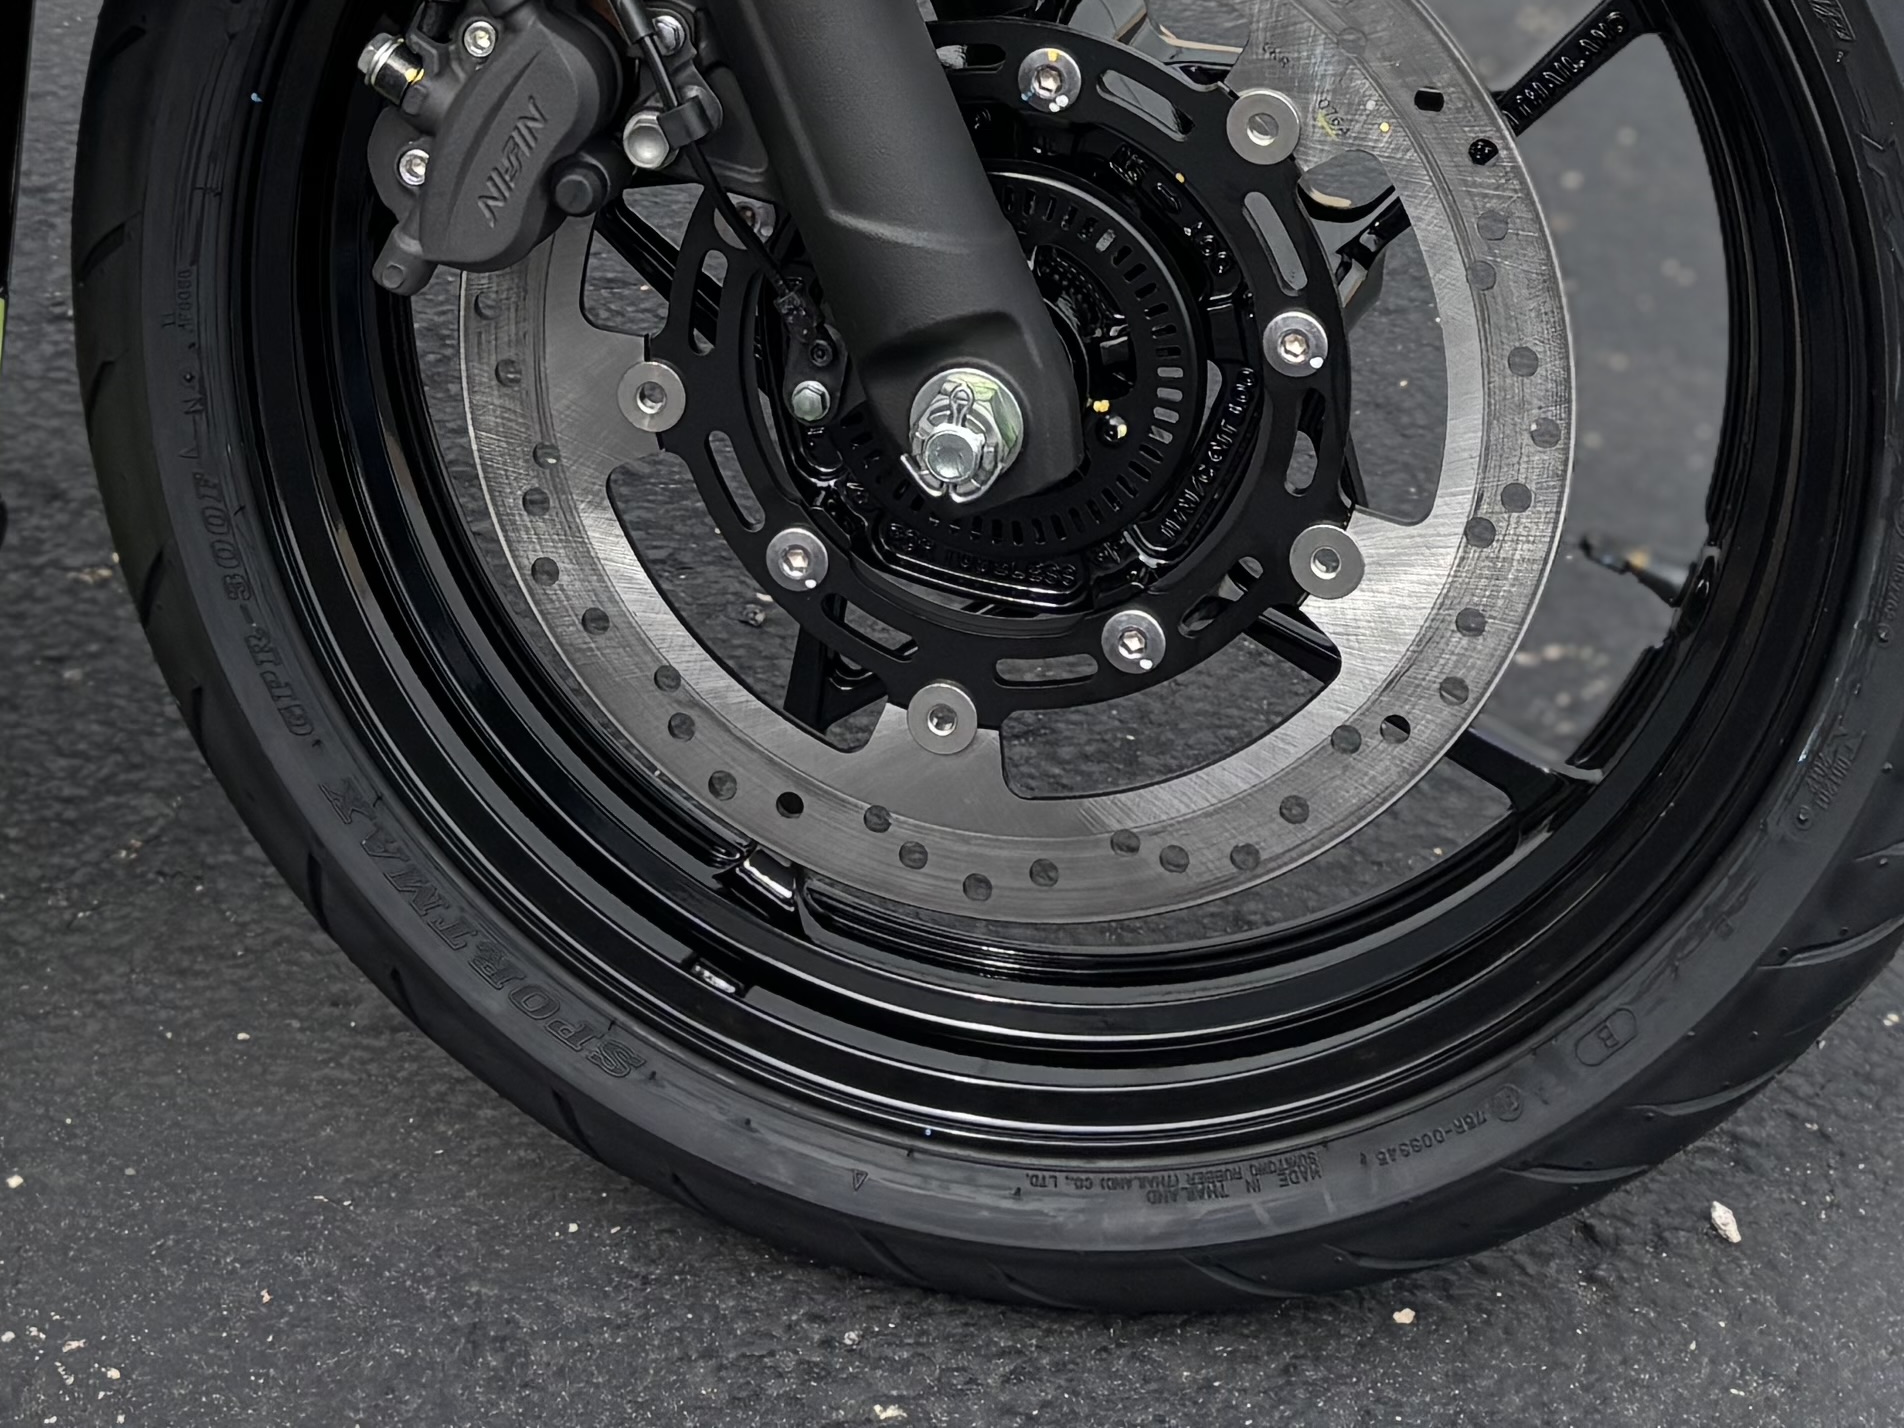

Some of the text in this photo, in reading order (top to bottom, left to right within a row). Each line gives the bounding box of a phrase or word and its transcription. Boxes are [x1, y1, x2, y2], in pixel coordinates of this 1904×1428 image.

[316, 775, 647, 1082] SPORTMAX
[1025, 1172, 1058, 1188] LTD.
[1144, 1165, 1321, 1206] MADE IN THAILAND
[1185, 1164, 1242, 1186] RUBBER
